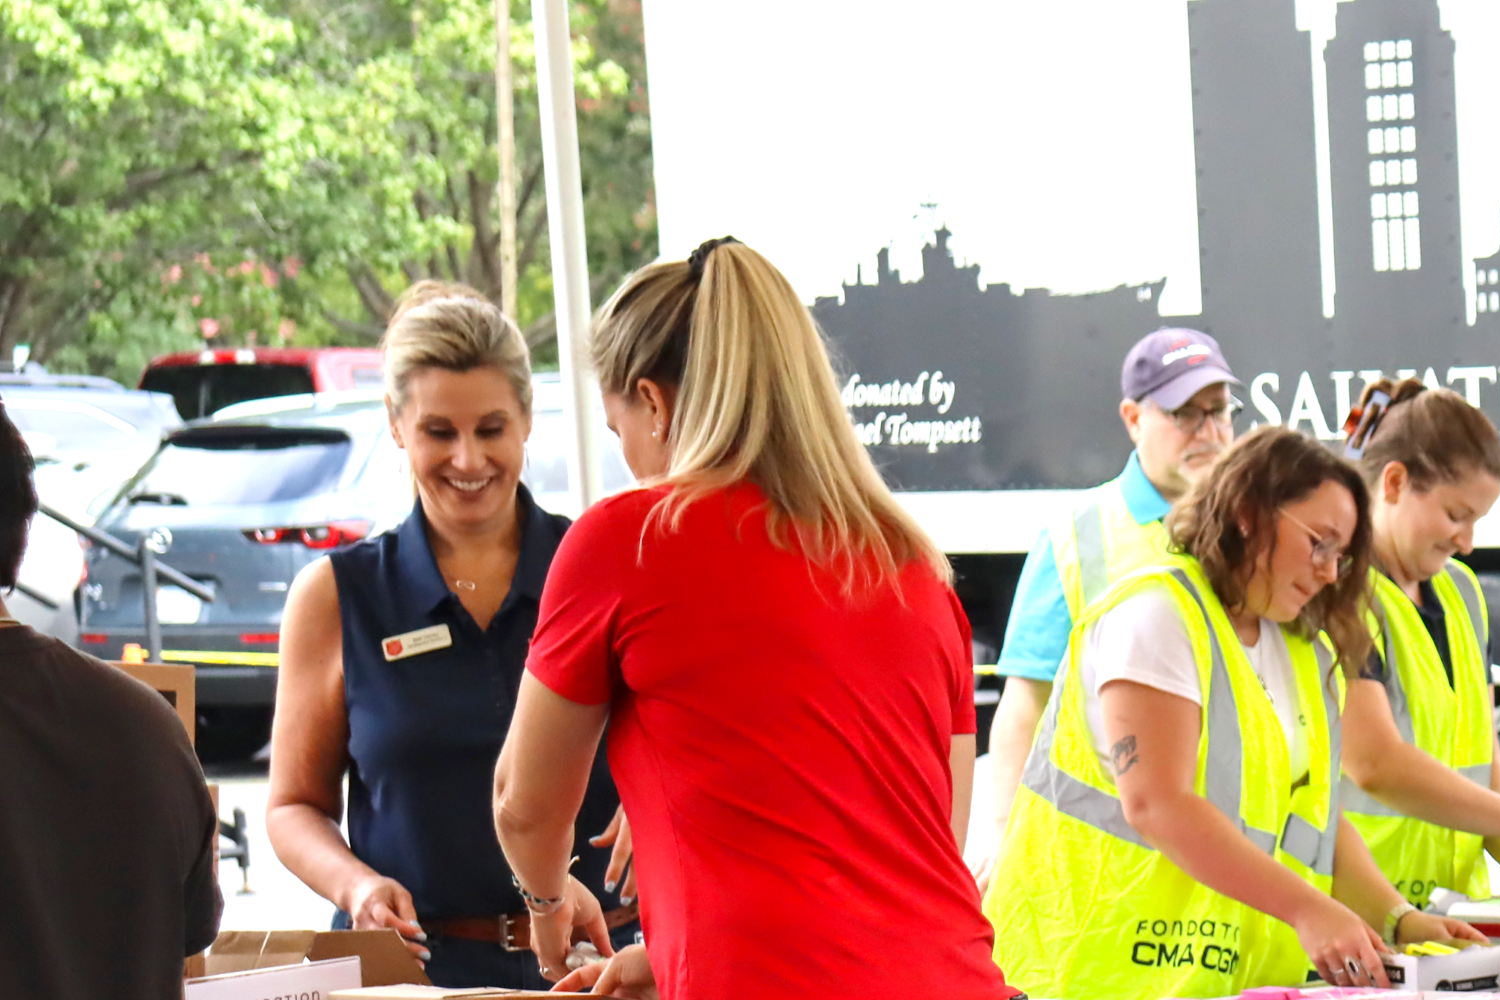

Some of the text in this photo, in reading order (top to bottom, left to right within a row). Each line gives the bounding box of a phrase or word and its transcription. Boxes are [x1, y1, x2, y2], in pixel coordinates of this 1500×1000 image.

[841, 370, 955, 414] donated by
[885, 412, 982, 453] Tompsett
[1131, 942, 1195, 968] CMA
